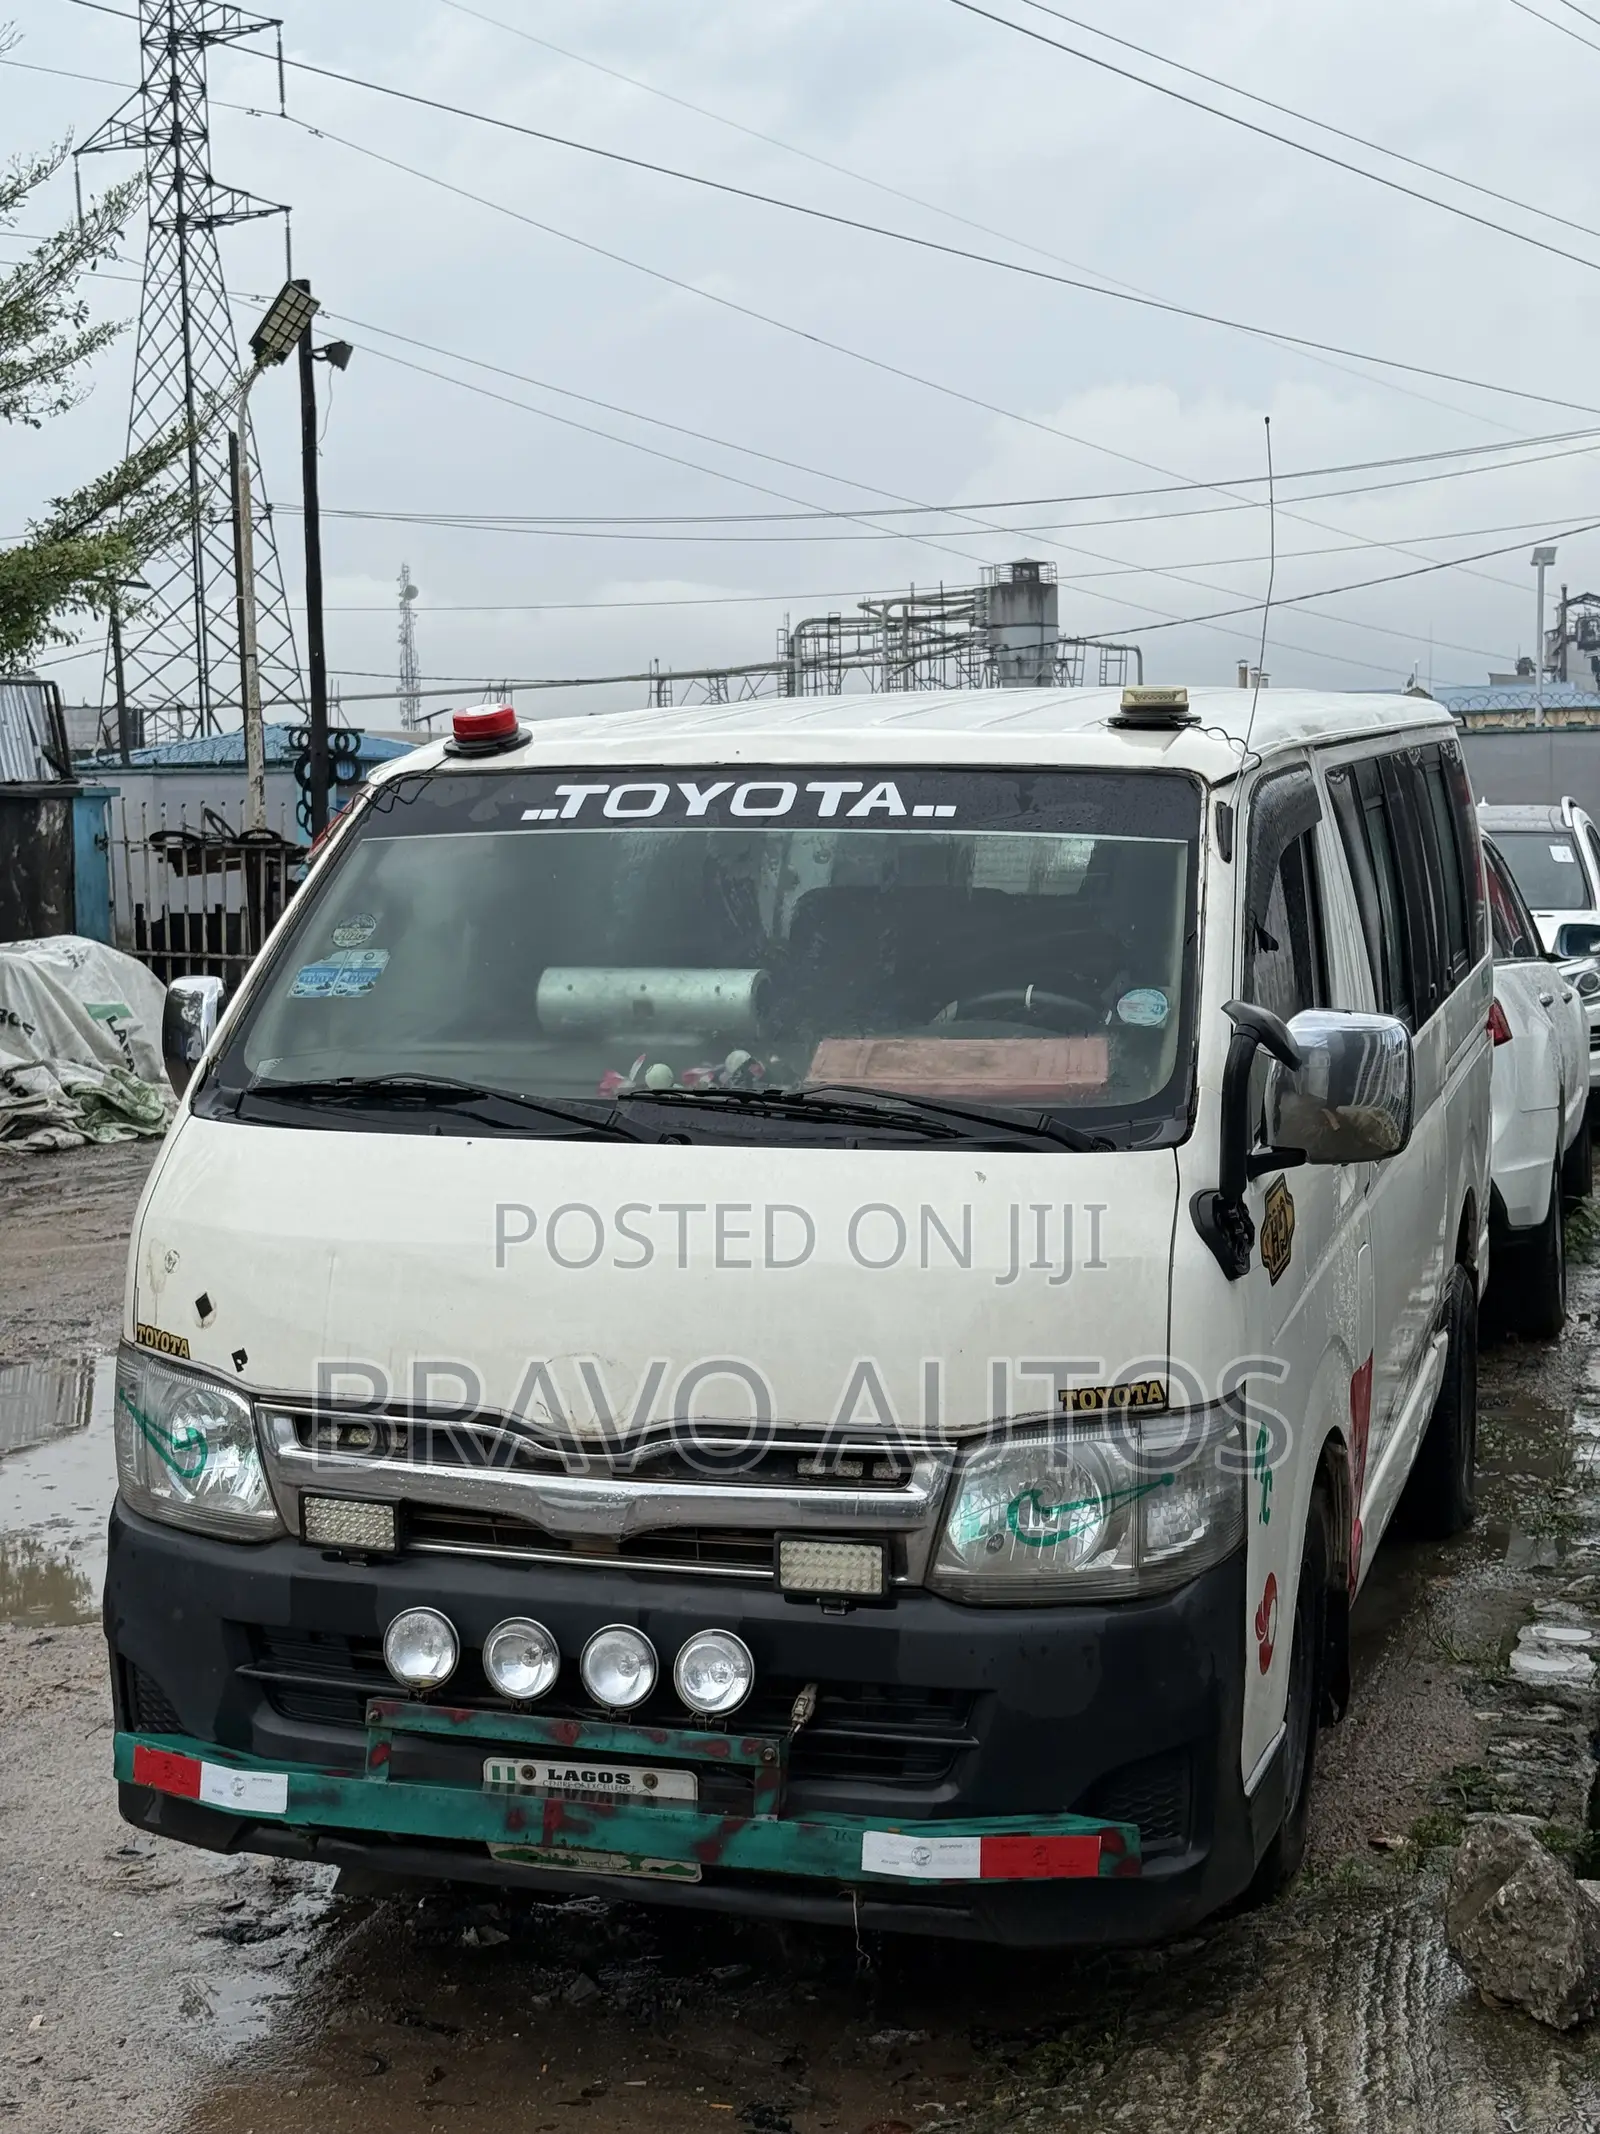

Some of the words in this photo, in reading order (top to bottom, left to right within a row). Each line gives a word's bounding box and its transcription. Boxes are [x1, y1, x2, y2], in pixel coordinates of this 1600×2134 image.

[137, 1324, 189, 1359] TOYOTA
[1059, 1381, 1165, 1411] TOYOTA
[547, 1768, 631, 1785] LAGOS
